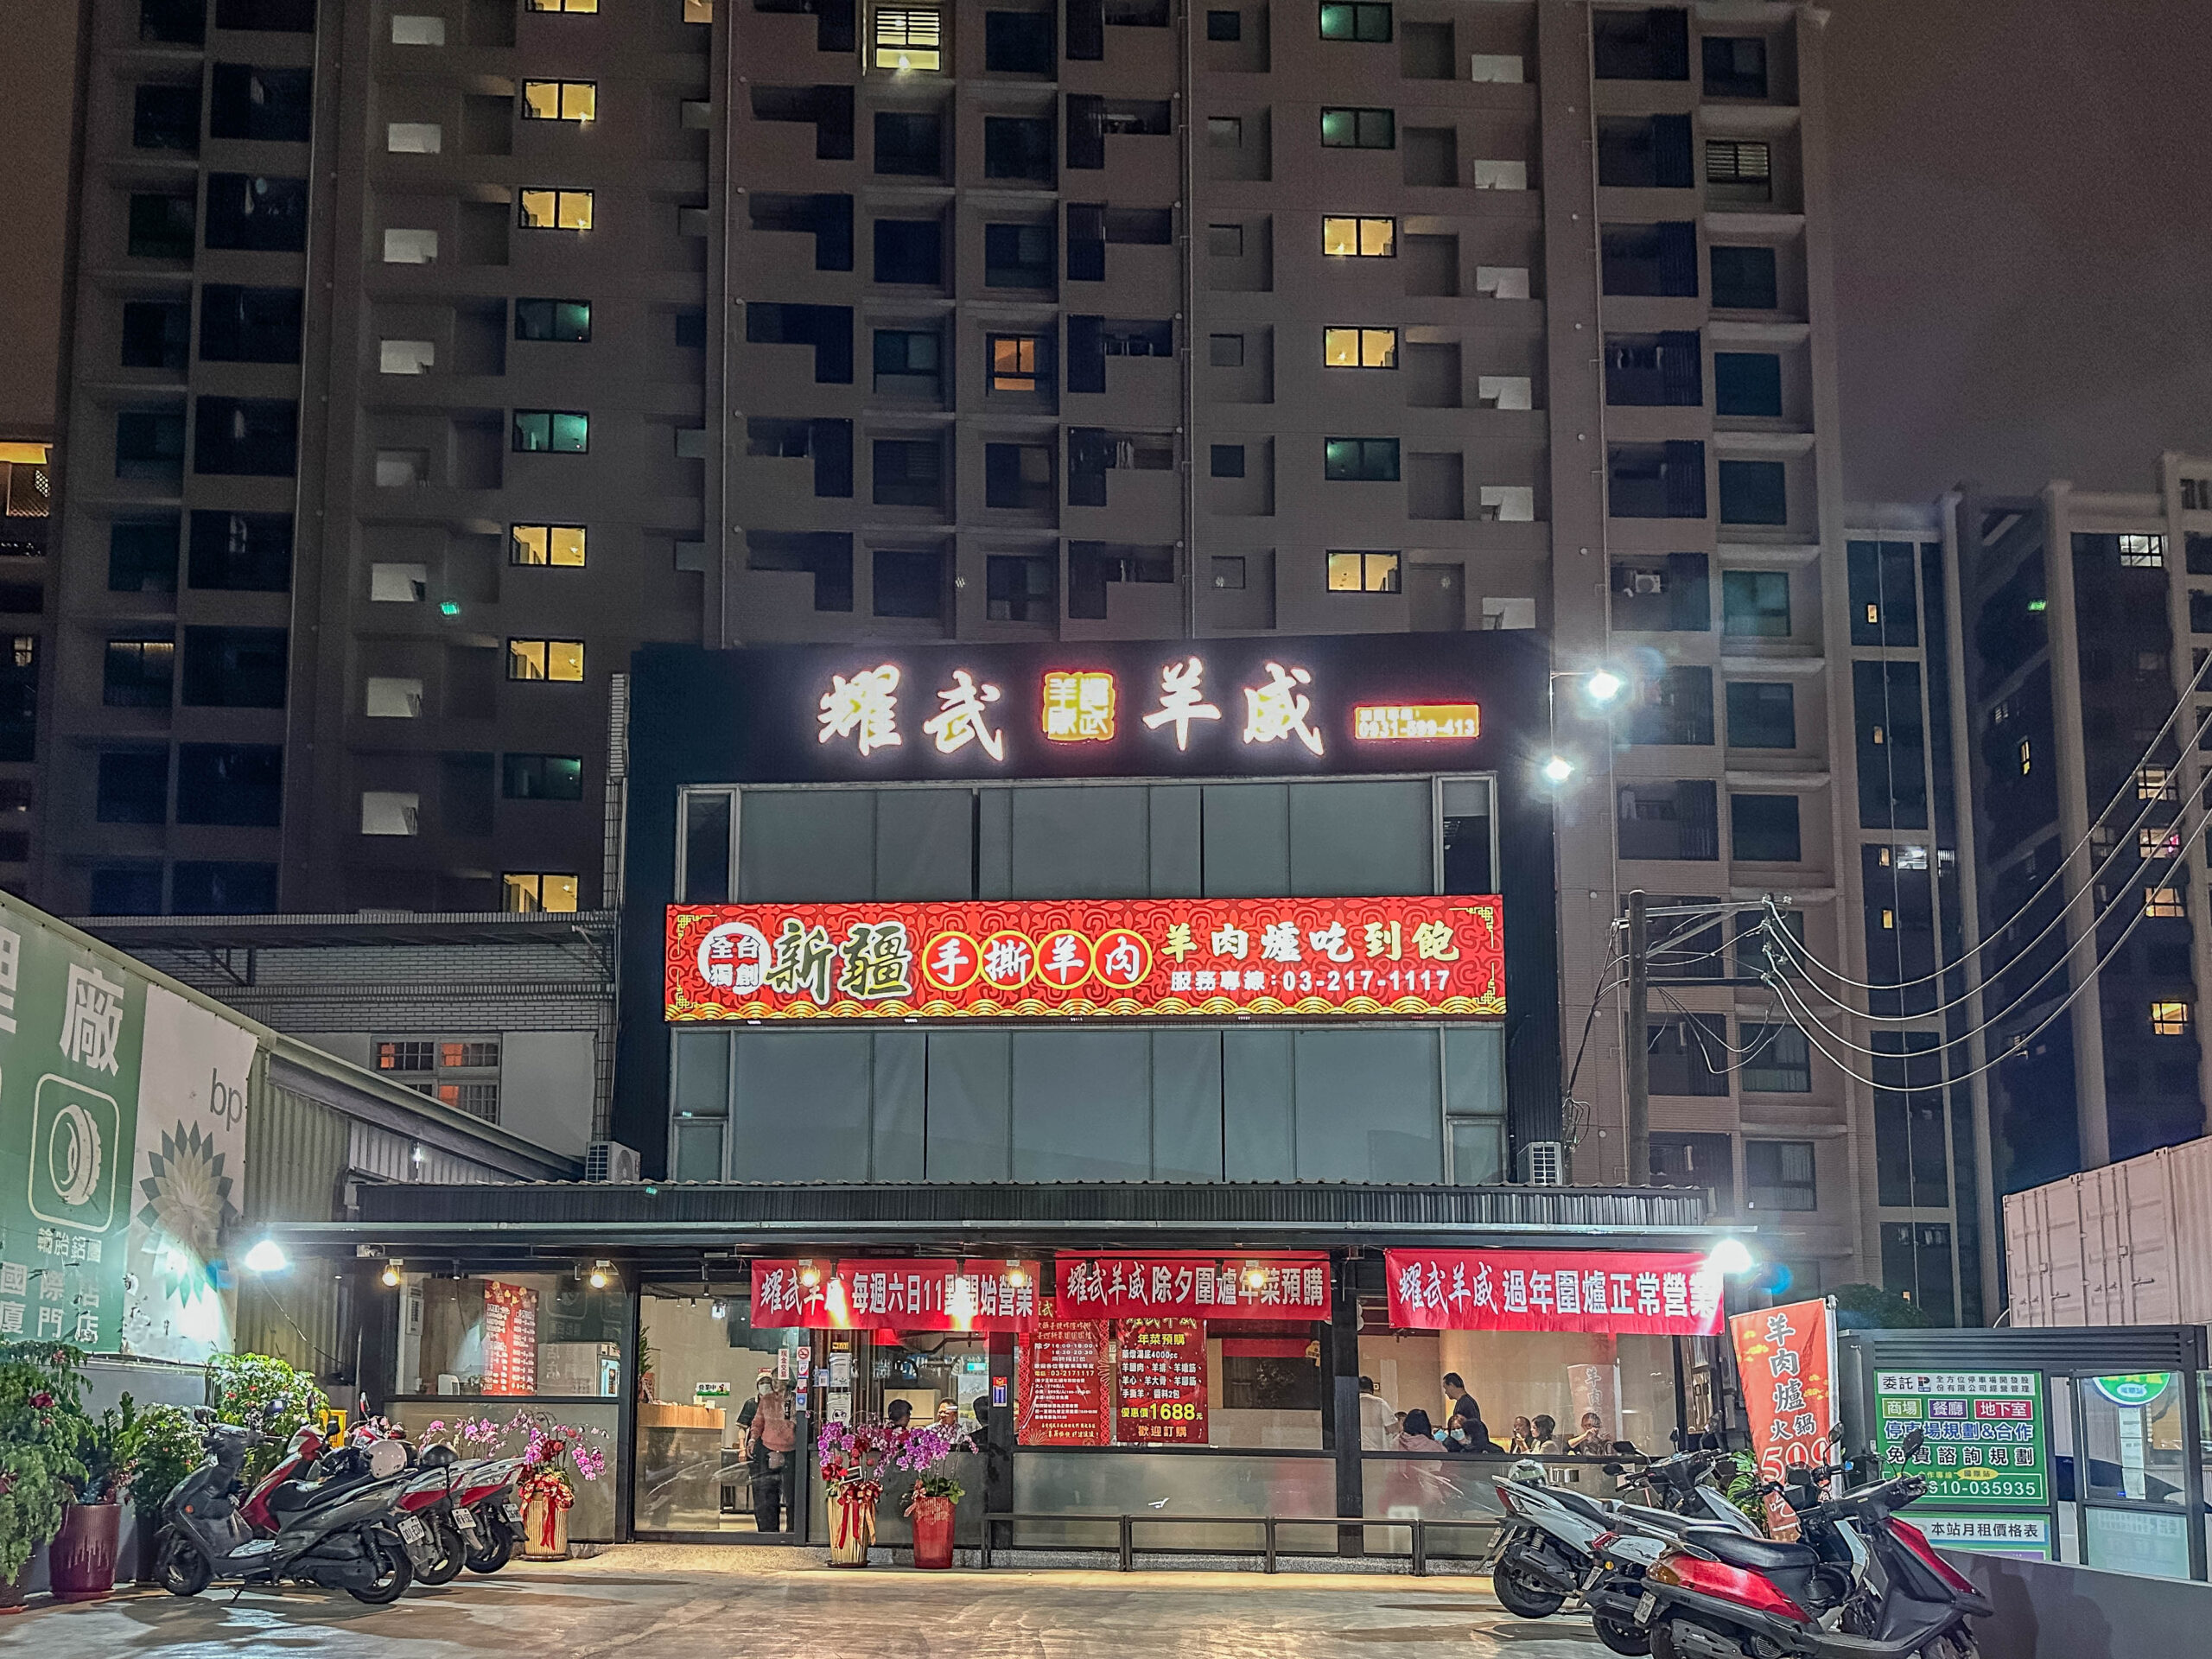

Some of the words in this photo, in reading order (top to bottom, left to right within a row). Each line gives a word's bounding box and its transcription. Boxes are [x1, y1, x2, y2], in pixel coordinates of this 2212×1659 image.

[710, 935, 760, 960] 全台
[766, 917, 912, 1005] 新疆
[930, 936, 1141, 983] 手撕羊肉
[1160, 919, 1460, 964] 羊肉爐吃到飽
[210, 1068, 242, 1131] bp
[1764, 1312, 1807, 1414] 羊肉爐
[1886, 1401, 1917, 1416] 商場
[1932, 1401, 1964, 1417] 餐廳
[1980, 1402, 2028, 1418] 地下室
[1931, 1522, 2038, 1538] 本站月租價格表
